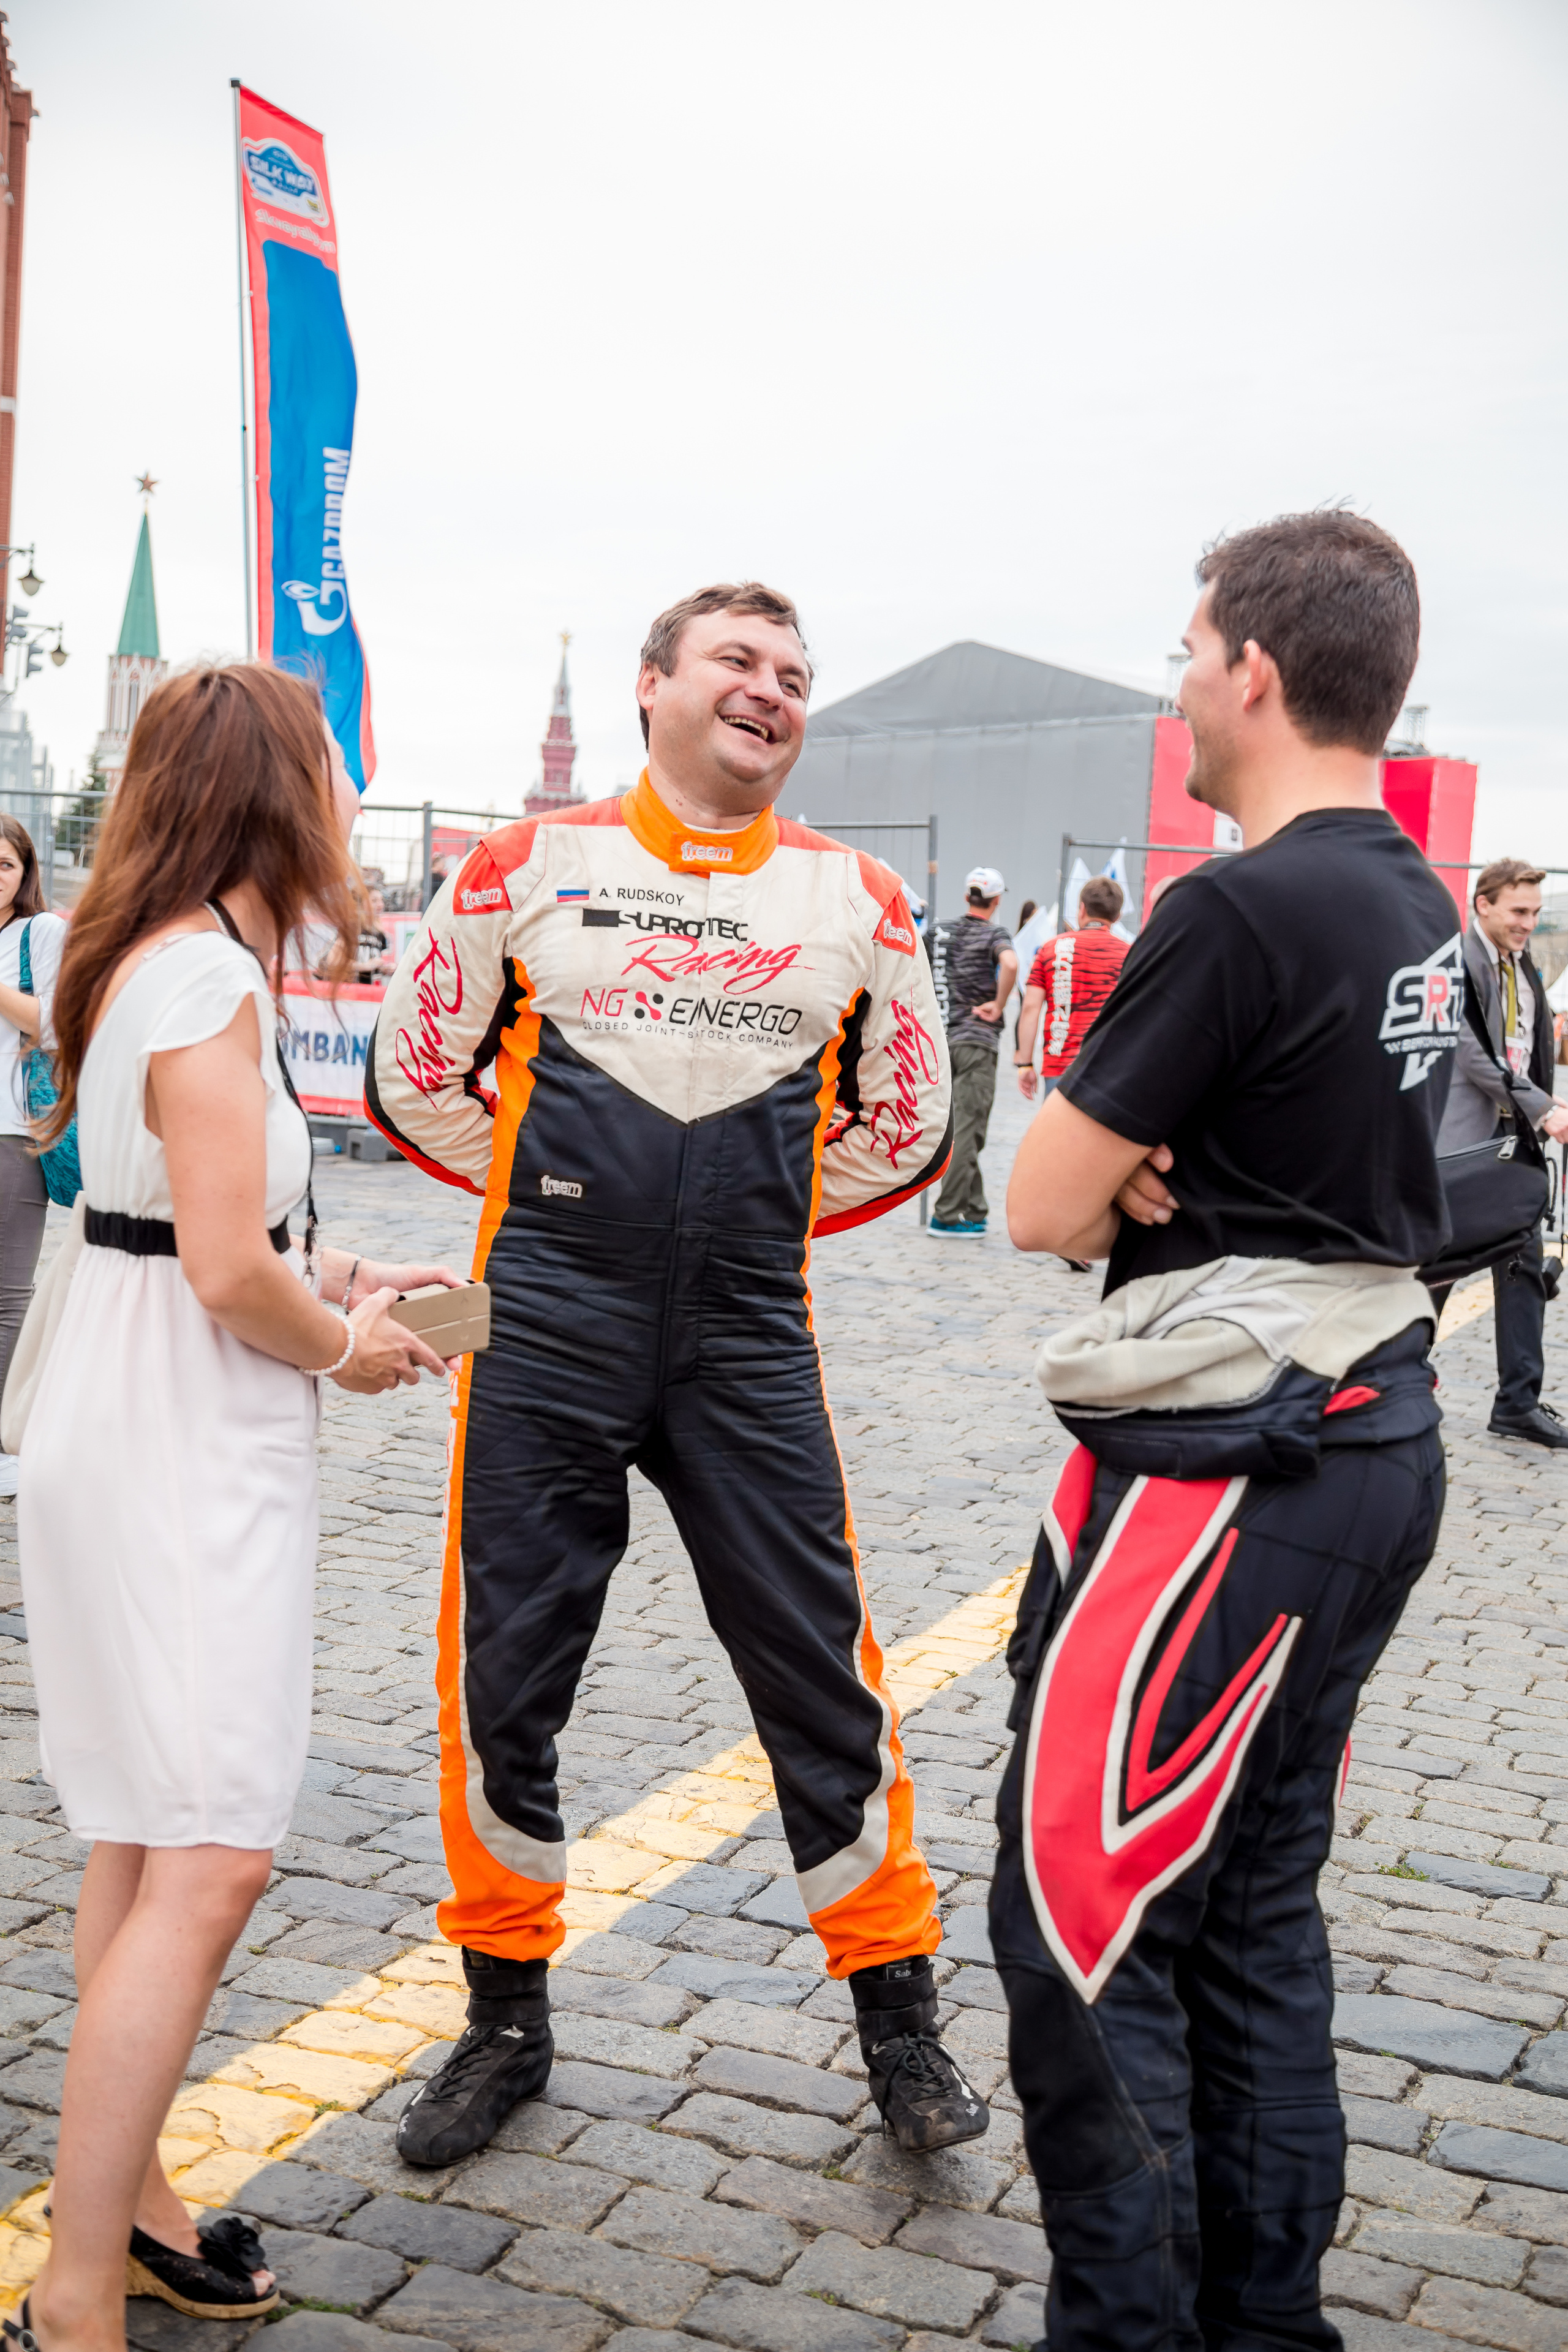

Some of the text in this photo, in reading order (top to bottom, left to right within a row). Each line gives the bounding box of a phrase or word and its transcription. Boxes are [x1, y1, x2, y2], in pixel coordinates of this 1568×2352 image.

[249, 154, 283, 181] SILK
[681, 841, 733, 861] freem
[461, 888, 502, 910] freem
[599, 888, 685, 906] A. RUDSKOY
[619, 909, 748, 941] SUPROTEC
[620, 933, 816, 995] Racing
[933, 925, 951, 1034] ECURITY
[580, 987, 803, 1035] NG ENERGO
[582, 1021, 629, 1030] CLOSED
[739, 1033, 794, 1050] COMPANY
[540, 1175, 583, 1199] freem
